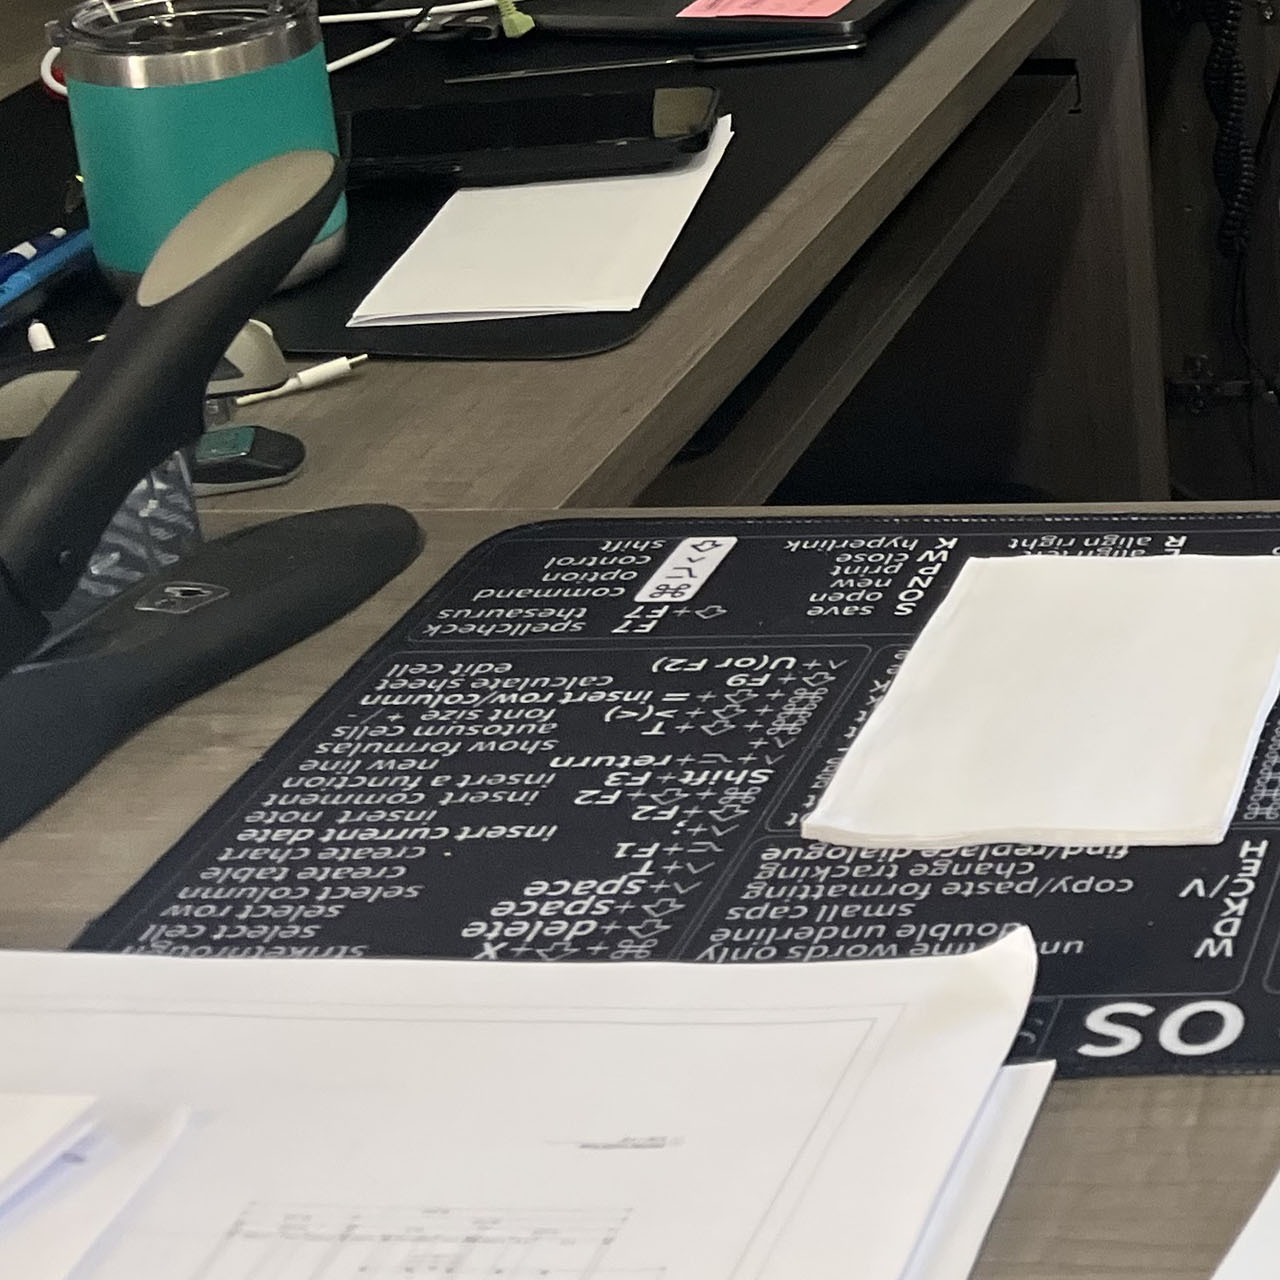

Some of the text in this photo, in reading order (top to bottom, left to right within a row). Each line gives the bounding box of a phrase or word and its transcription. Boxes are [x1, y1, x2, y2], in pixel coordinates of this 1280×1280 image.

[600, 540, 666, 552] shift
[784, 536, 918, 551] hyperlink
[1008, 535, 1151, 550] align right
[544, 556, 651, 569] control
[836, 553, 909, 565] close
[542, 569, 637, 583] option
[831, 563, 903, 577] print
[472, 587, 625, 601] command
[810, 589, 882, 602] open
[438, 608, 587, 620] thesaurus
[807, 606, 874, 615] save
[423, 620, 586, 636] spellcheck
[315, 740, 558, 757] show formulas
[262, 791, 539, 807] insert comment
[236, 827, 449, 845] current date
[200, 866, 406, 883] create table
[754, 859, 1034, 882] change tracking
[178, 886, 422, 903] select column
[741, 876, 1133, 902] copy/paste formatting
[726, 902, 915, 922] small caps
[1078, 1001, 1244, 1056] OS
